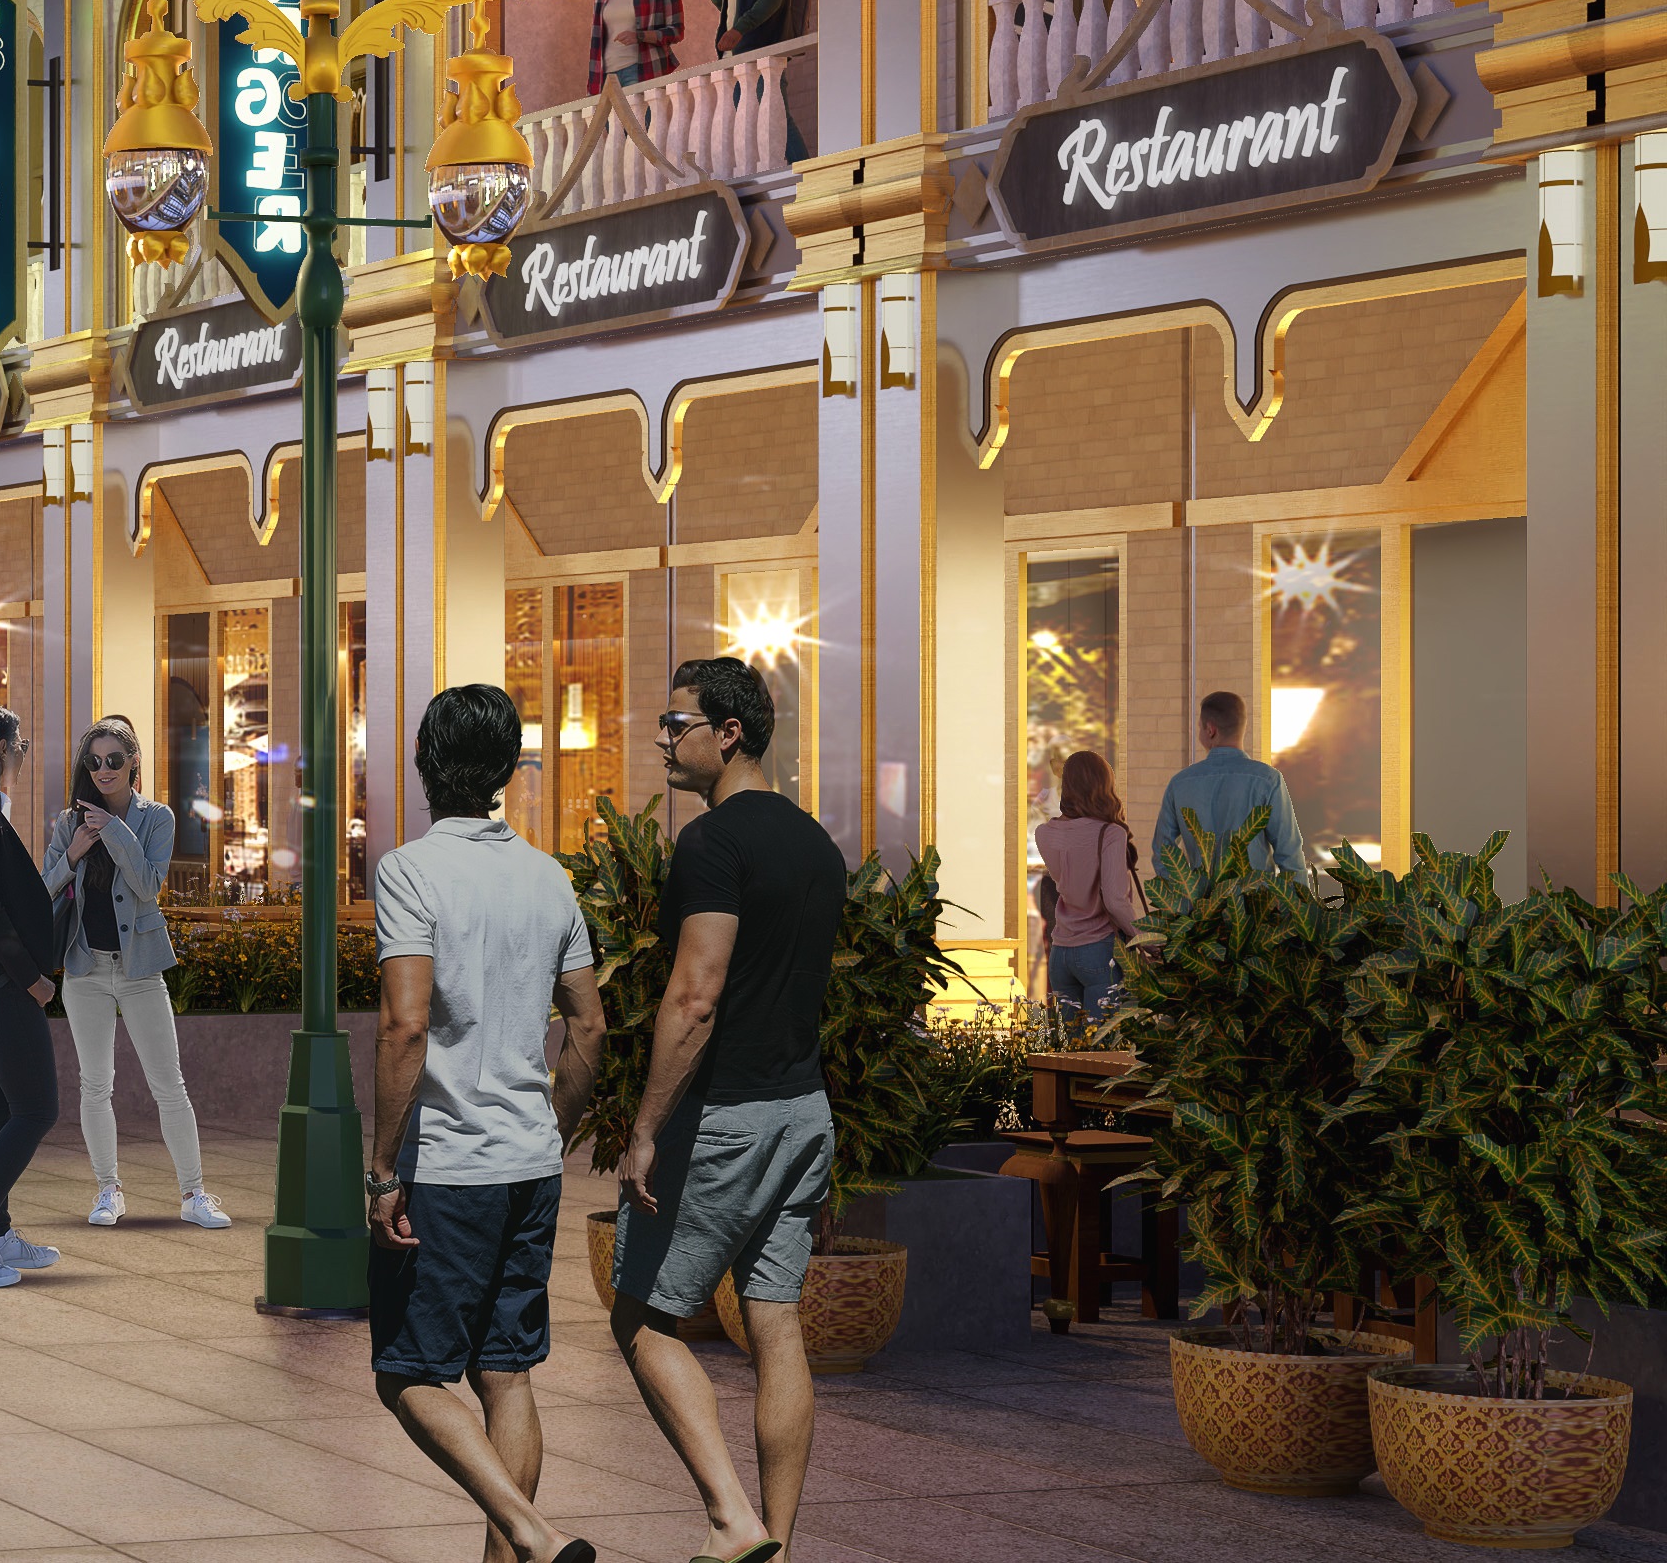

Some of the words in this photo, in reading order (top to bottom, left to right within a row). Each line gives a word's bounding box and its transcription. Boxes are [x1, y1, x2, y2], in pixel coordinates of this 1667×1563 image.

[1058, 66, 1349, 210] Restaurant
[522, 210, 708, 317] Restaurant
[155, 322, 286, 390] Restaurant
